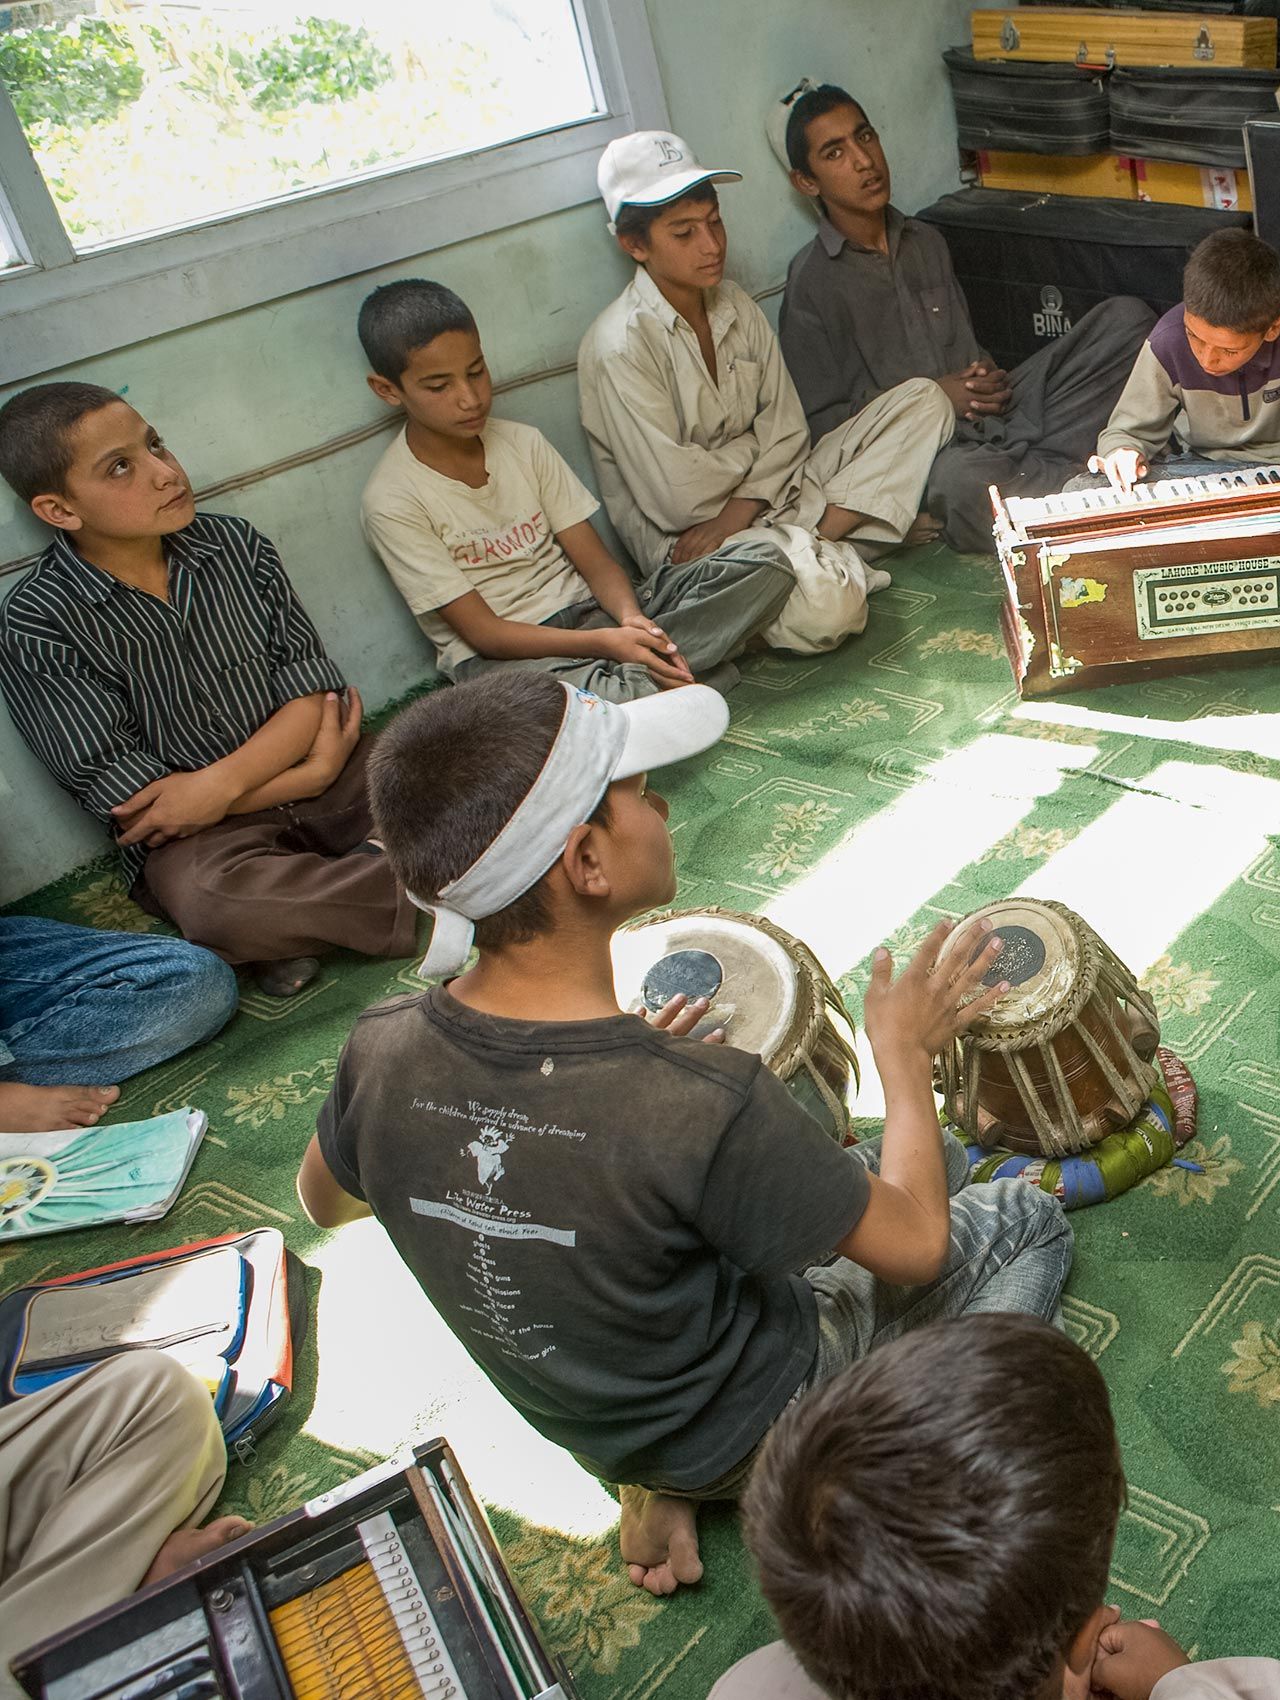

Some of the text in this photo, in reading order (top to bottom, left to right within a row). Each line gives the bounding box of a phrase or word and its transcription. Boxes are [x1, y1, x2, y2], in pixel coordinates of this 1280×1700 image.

[1033, 313, 1071, 336] BINA
[1161, 559, 1269, 579] LAHORE MUSIC HOUSE
[410, 1098, 424, 1110] for
[426, 1101, 437, 1111] the
[439, 1105, 467, 1119] children
[469, 1110, 500, 1125] deprived
[508, 1120, 536, 1132] advance
[538, 1123, 549, 1136] of
[548, 1124, 587, 1142] dreaming
[468, 1101, 481, 1112] We
[482, 1106, 507, 1119] supply
[466, 1196, 495, 1213] Water
[500, 1205, 532, 1218] Press
[541, 1345, 557, 1358] girls
